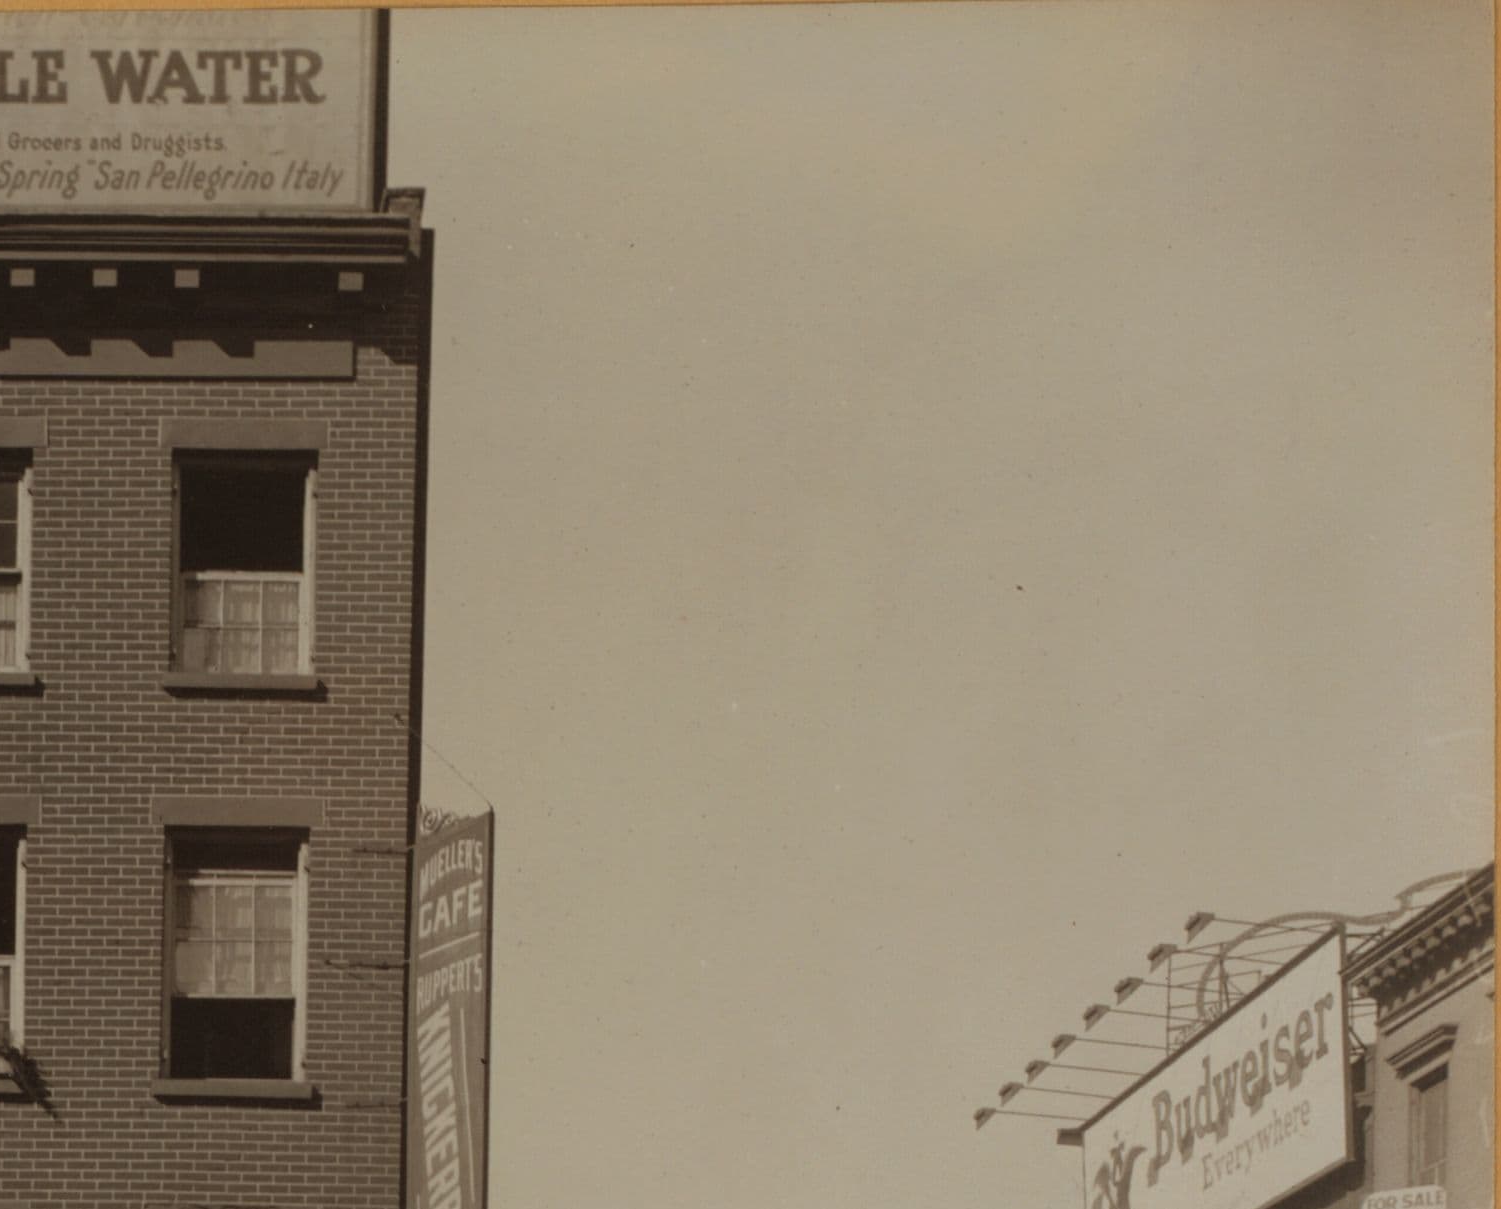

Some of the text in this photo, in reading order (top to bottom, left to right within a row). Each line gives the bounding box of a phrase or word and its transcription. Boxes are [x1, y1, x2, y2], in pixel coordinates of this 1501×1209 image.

[89, 49, 327, 104] WATER
[7, 131, 82, 152] Grocers
[88, 131, 123, 152] and
[145, 160, 275, 200] Pellegrino
[281, 161, 344, 199] Italy
[418, 838, 484, 891] MUELLER'S
[417, 879, 484, 938] CAFE
[416, 952, 484, 1009] RUPPERT'S
[1148, 992, 1335, 1185] Budweiser
[1402, 1190, 1445, 1209] SALE
